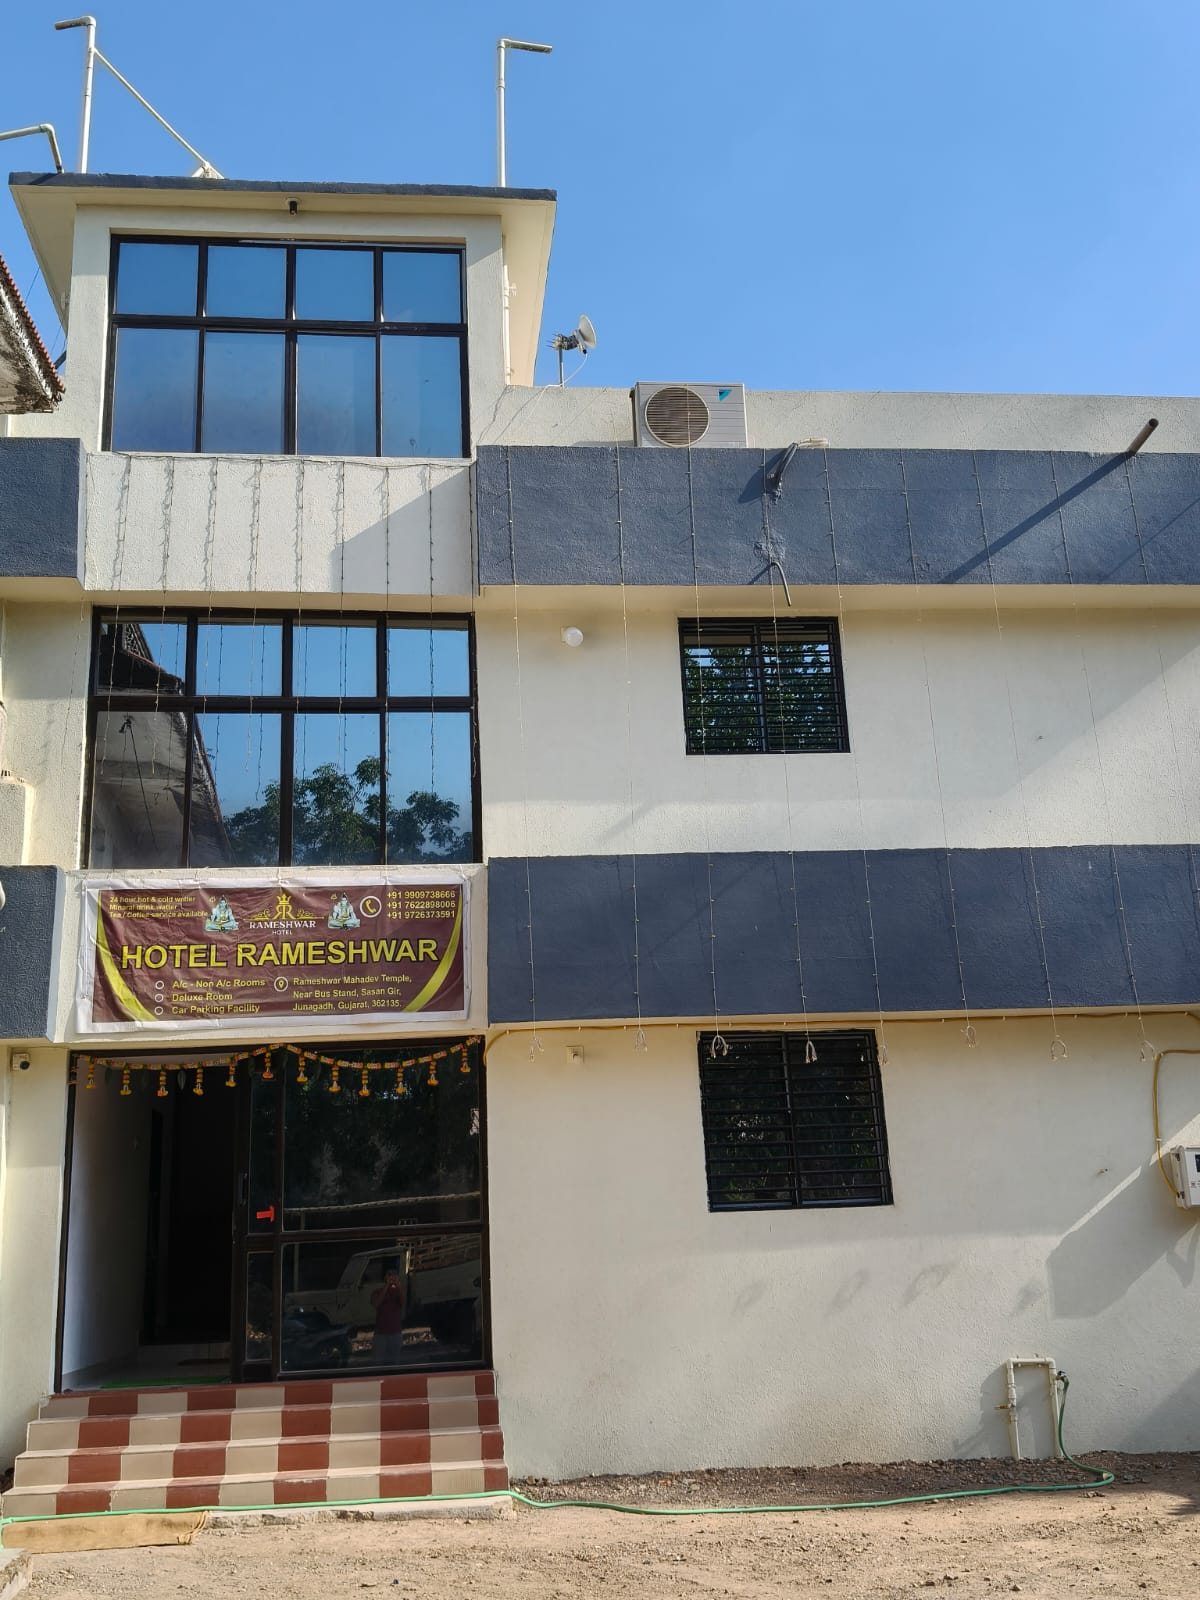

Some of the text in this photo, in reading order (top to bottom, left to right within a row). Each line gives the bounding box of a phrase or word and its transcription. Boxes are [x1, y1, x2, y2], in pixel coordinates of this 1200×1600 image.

[387, 891, 402, 899] +91
[387, 901, 402, 909] +91
[405, 911, 455, 919] 9726373591
[249, 920, 316, 928] RAMESHWAR
[121, 938, 439, 969] HOTEL RAMESHWAR
[195, 980, 213, 988] Non
[216, 979, 231, 987] A/c
[233, 978, 265, 987] Rooms
[293, 974, 412, 986] Rameshwar Mahadev Temple,
[172, 992, 233, 1002] Deluxe Room
[293, 991, 312, 999] Near
[314, 990, 331, 998] Bus
[332, 989, 359, 998] Stand,
[360, 988, 385, 996] Sasan
[172, 1003, 260, 1014] Car Parking Facility
[293, 1002, 336, 1012] Junagadh,
[337, 1001, 369, 1010] Gujarat,
